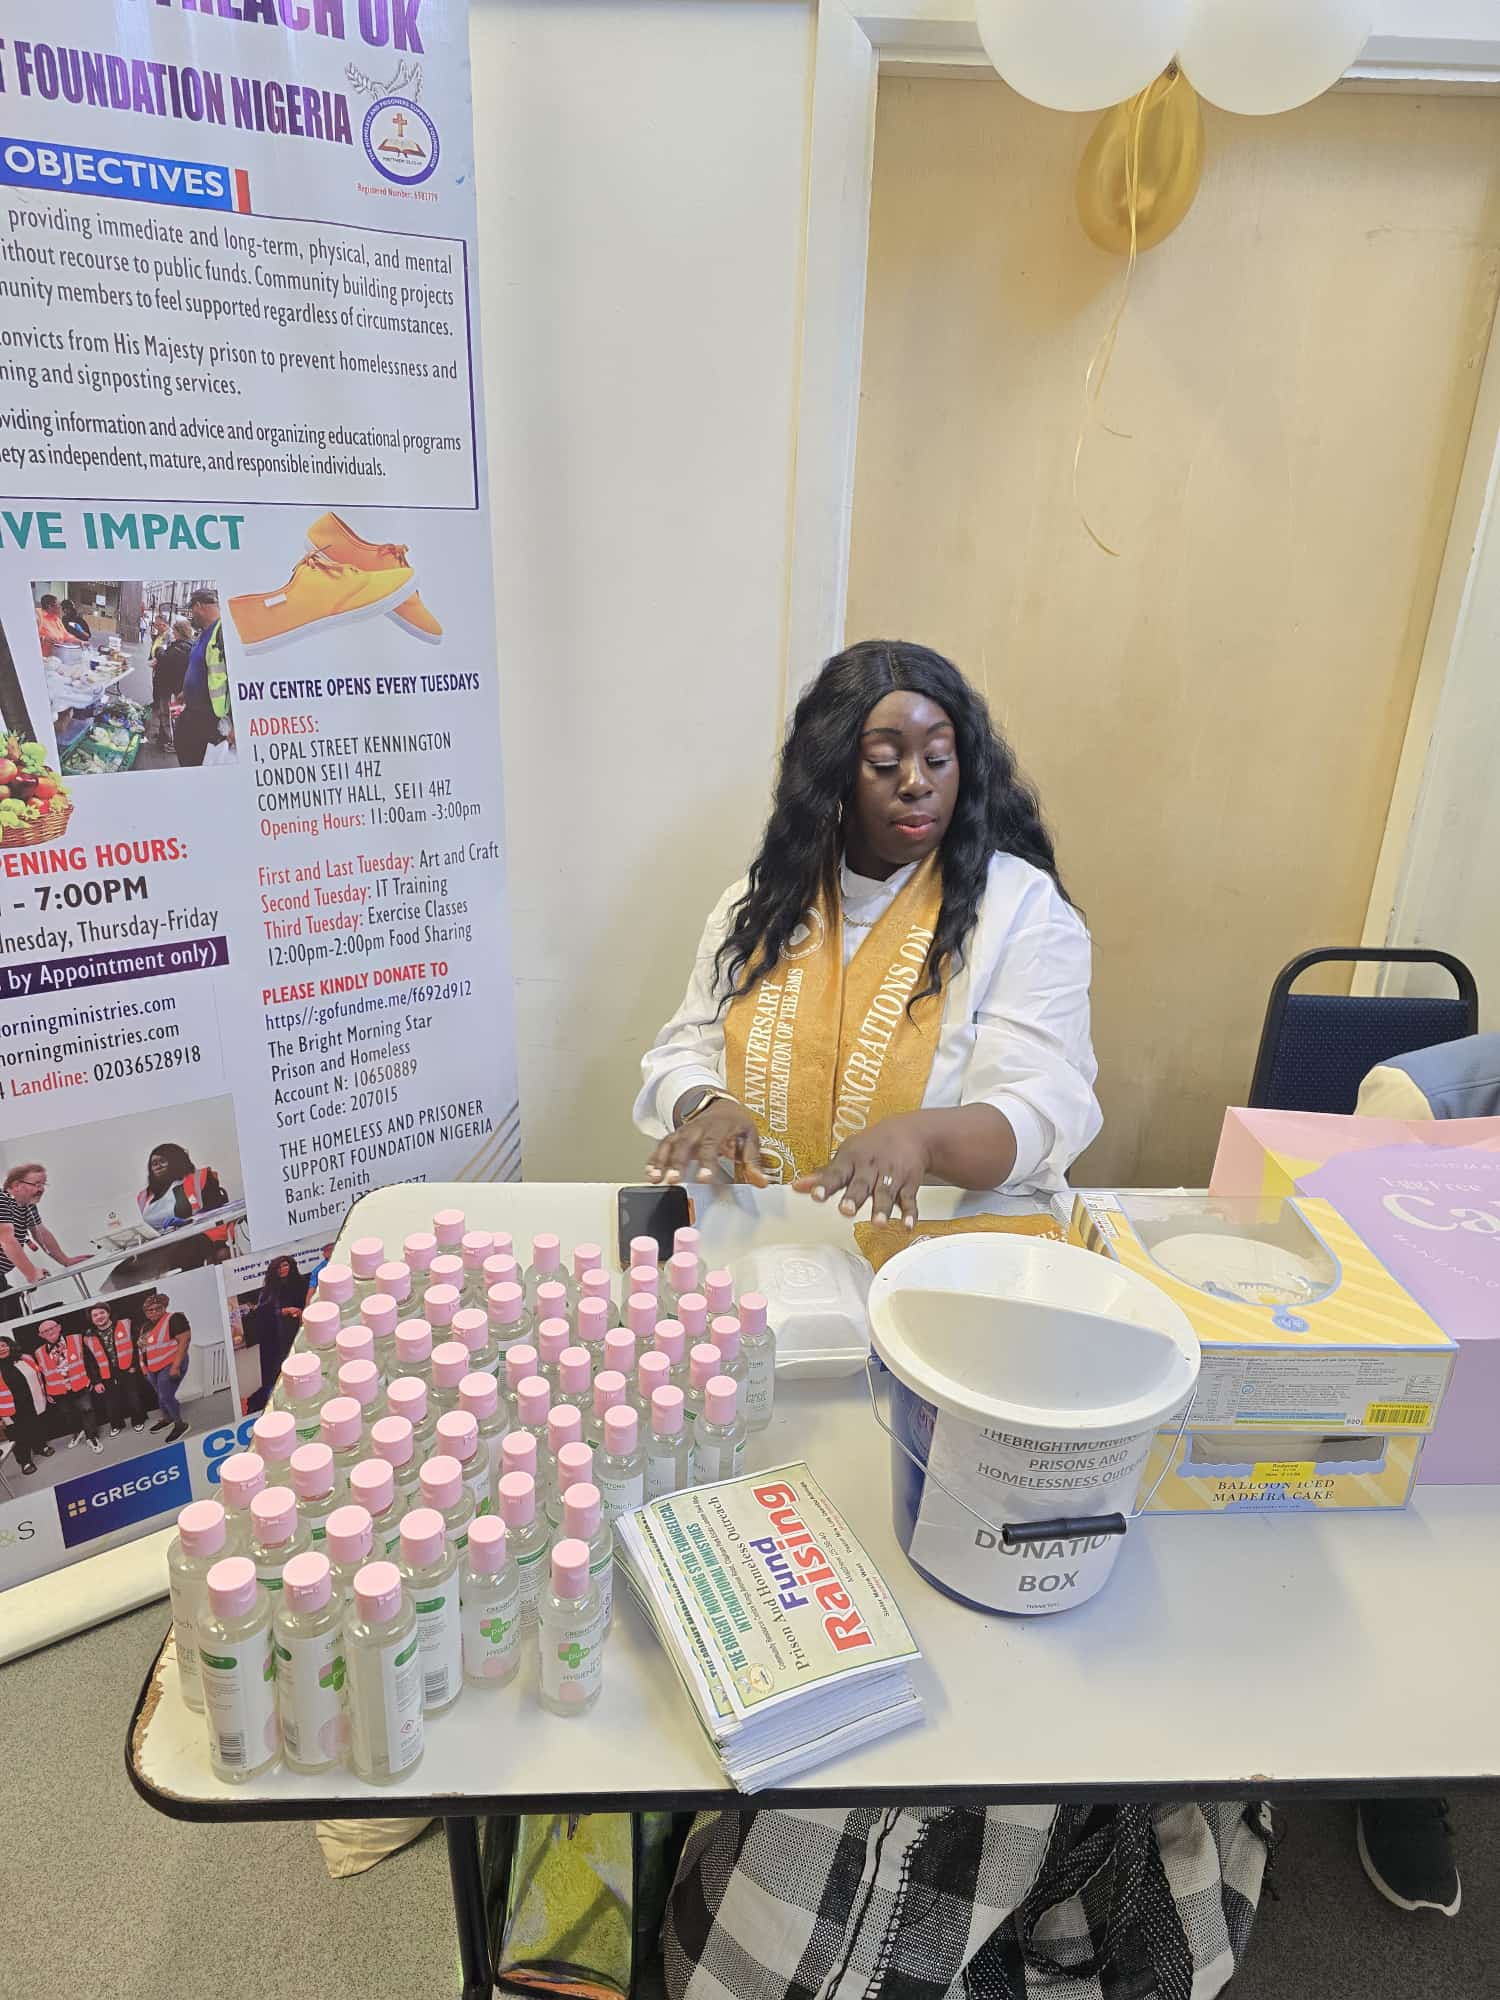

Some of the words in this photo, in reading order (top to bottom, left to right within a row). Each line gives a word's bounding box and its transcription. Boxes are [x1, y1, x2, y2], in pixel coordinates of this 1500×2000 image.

[14, 40, 226, 125] FOUNDATION
[230, 76, 353, 145] NIGERIA
[4, 145, 225, 198] OBJECTIVES
[8, 207, 93, 240] providing
[96, 213, 183, 244] immediate
[189, 226, 219, 248] and
[224, 226, 303, 261] long-term,
[309, 237, 370, 267] physical,
[374, 248, 400, 269] and
[405, 254, 452, 275] mental
[59, 250, 129, 272] recourse
[154, 255, 203, 282] public
[206, 259, 251, 286] funds.
[255, 264, 339, 299] Community
[343, 272, 397, 306] building
[400, 283, 454, 309] projects
[57, 281, 133, 306] members
[154, 287, 182, 311] feel
[185, 295, 260, 321] supported
[263, 302, 337, 327] regardless
[356, 307, 454, 336] circumstances.
[68, 328, 109, 353] from
[113, 331, 140, 356] His
[144, 334, 204, 366] Majesty
[209, 341, 257, 367] prison
[279, 350, 336, 373] prevent
[339, 349, 429, 378] homelessness
[432, 360, 457, 380] and
[78, 364, 173, 397] signposting
[175, 372, 241, 395] services.
[54, 409, 146, 436] information
[180, 418, 224, 439] advice
[256, 423, 325, 449] organizing
[328, 425, 400, 448] educational
[403, 435, 461, 455] programs
[47, 443, 148, 471] independent,
[150, 452, 206, 472] mature,
[237, 453, 309, 477] responsible
[311, 455, 386, 477] individuals.
[84, 513, 245, 551] IMPACT
[238, 680, 265, 702] DAY
[269, 679, 323, 700] CENTRE
[326, 677, 371, 697] OPENS
[376, 676, 417, 695] EVERY
[420, 672, 480, 693] TUESDAYS
[249, 714, 320, 737] ADDRESS:
[269, 741, 307, 762] OPAL
[311, 737, 359, 758] STREET
[364, 731, 452, 755] KENNINGTON
[255, 764, 316, 788] LONDON
[354, 760, 382, 779] 4HZ
[257, 788, 342, 813] COMMUNITY
[348, 784, 386, 804] HALL,
[428, 779, 452, 797] 4HZ
[260, 816, 318, 841] Opening
[322, 811, 366, 832] Hours:
[370, 804, 427, 826] 11:00am
[431, 801, 481, 822] -3:00pm
[95, 837, 188, 869] HOURS:
[258, 866, 291, 888] First
[294, 863, 321, 883] and
[325, 858, 354, 878] Last
[357, 851, 415, 876] Tuesday:
[419, 849, 440, 869] Art
[444, 846, 465, 866] and
[468, 841, 500, 864] Craft
[34, 876, 149, 912] 7:00PM
[260, 889, 310, 914] Second
[314, 883, 372, 907] Tuesday:
[392, 875, 448, 897] Training
[77, 907, 219, 943] Thursday-Friday
[263, 916, 302, 940] Third
[305, 911, 364, 934] Tuesday:
[367, 905, 421, 925] Exercise
[425, 899, 468, 918] Classes
[268, 933, 385, 967] 12:00pm-2:00pm
[389, 927, 420, 947] Food
[424, 922, 472, 943] Sharing
[899, 924, 934, 963] ON
[40, 952, 165, 989] Appointment
[170, 940, 218, 967] only)
[262, 981, 316, 1006] PLEASE
[319, 972, 369, 996] KINDLY
[373, 963, 426, 986] DONATE
[430, 961, 449, 977] TO
[785, 968, 804, 993] BMS
[780, 995, 798, 1020] THE
[268, 1040, 293, 1059] The
[298, 1030, 342, 1055] Bright
[347, 1018, 402, 1041] Morning
[405, 1014, 433, 1032] Star
[745, 979, 783, 1118] ANNIVERSARY
[776, 1021, 794, 1039] OF
[11, 1070, 89, 1097] Landline:
[93, 1044, 201, 1082] 02036528918
[271, 1061, 316, 1083] Prison
[320, 1053, 346, 1073] and
[350, 1042, 411, 1065] Homeless
[274, 1081, 329, 1105] Account
[353, 1058, 418, 1088] 10650889
[276, 1108, 306, 1129] Sort
[309, 1100, 346, 1121] Code:
[351, 1086, 398, 1111] 207015
[768, 1041, 793, 1133] CELEBRATION
[280, 1138, 307, 1160] THE
[312, 1120, 383, 1153] HOMELESS
[387, 1114, 415, 1135] AND
[419, 1099, 484, 1126] PRISONER
[282, 1151, 346, 1183] SUPPORT
[350, 1129, 435, 1165] FOUNDATION
[439, 1117, 494, 1142] NIGERIA
[285, 1183, 325, 1204] Bank:
[329, 1169, 370, 1193] Zenith
[288, 1200, 346, 1226] Number:
[977, 1461, 1098, 1490] HOMELESSNESS
[1029, 1456, 1095, 1472] PRISONS
[1099, 1449, 1129, 1466] AND
[91, 1464, 181, 1509] GREGGS
[1213, 1491, 1287, 1502] MADEIRA
[1292, 1490, 1334, 1501] CAKE
[1218, 1480, 1291, 1491] BALLOON
[1297, 1479, 1335, 1490] ICED
[656, 1501, 692, 1553] EVANGELICAL
[685, 1521, 720, 1568] MINISTRIES
[679, 1550, 703, 1575] STAR
[733, 1541, 772, 1596] Homeless
[750, 1536, 809, 1610] Fund
[752, 1483, 873, 1652] Raising
[1018, 1570, 1080, 1593] BOX
[690, 1573, 723, 1616] MORNING
[707, 1564, 753, 1633] INTERNATIONAL
[762, 1597, 786, 1624] And
[710, 1613, 740, 1651] BRIGHT
[782, 1624, 811, 1671] Prison
[726, 1647, 750, 1671] THE
